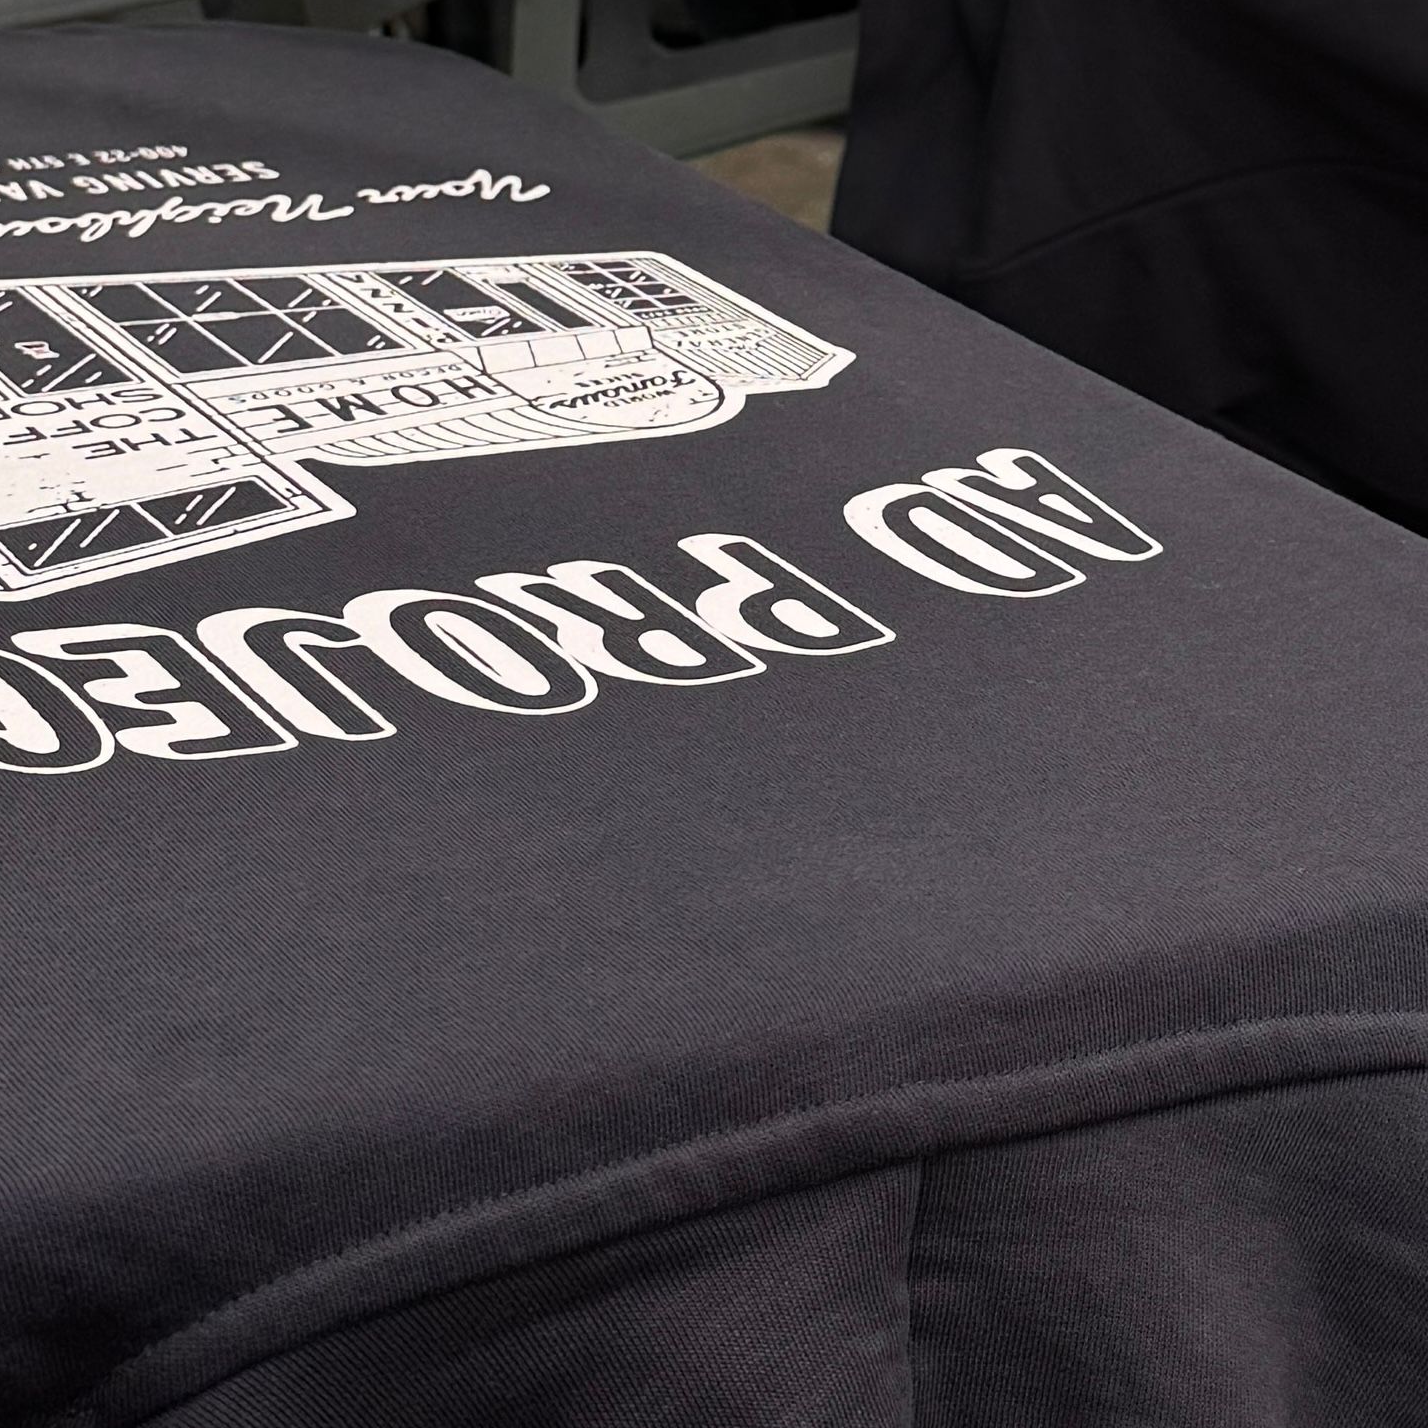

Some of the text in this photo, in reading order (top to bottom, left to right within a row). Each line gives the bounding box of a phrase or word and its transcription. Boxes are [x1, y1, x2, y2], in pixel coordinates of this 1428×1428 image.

[67, 152, 91, 167] E
[93, 145, 188, 164] 400-22
[71, 160, 280, 196] SERVING
[356, 169, 549, 205] Your
[382, 364, 462, 382] DECOR
[228, 383, 334, 404] GOODS
[247, 376, 497, 433] HOME
[548, 370, 696, 410] Famous
[603, 390, 676, 408] WORLD
[72, 428, 217, 460] THE
[845, 448, 1162, 598] AD
